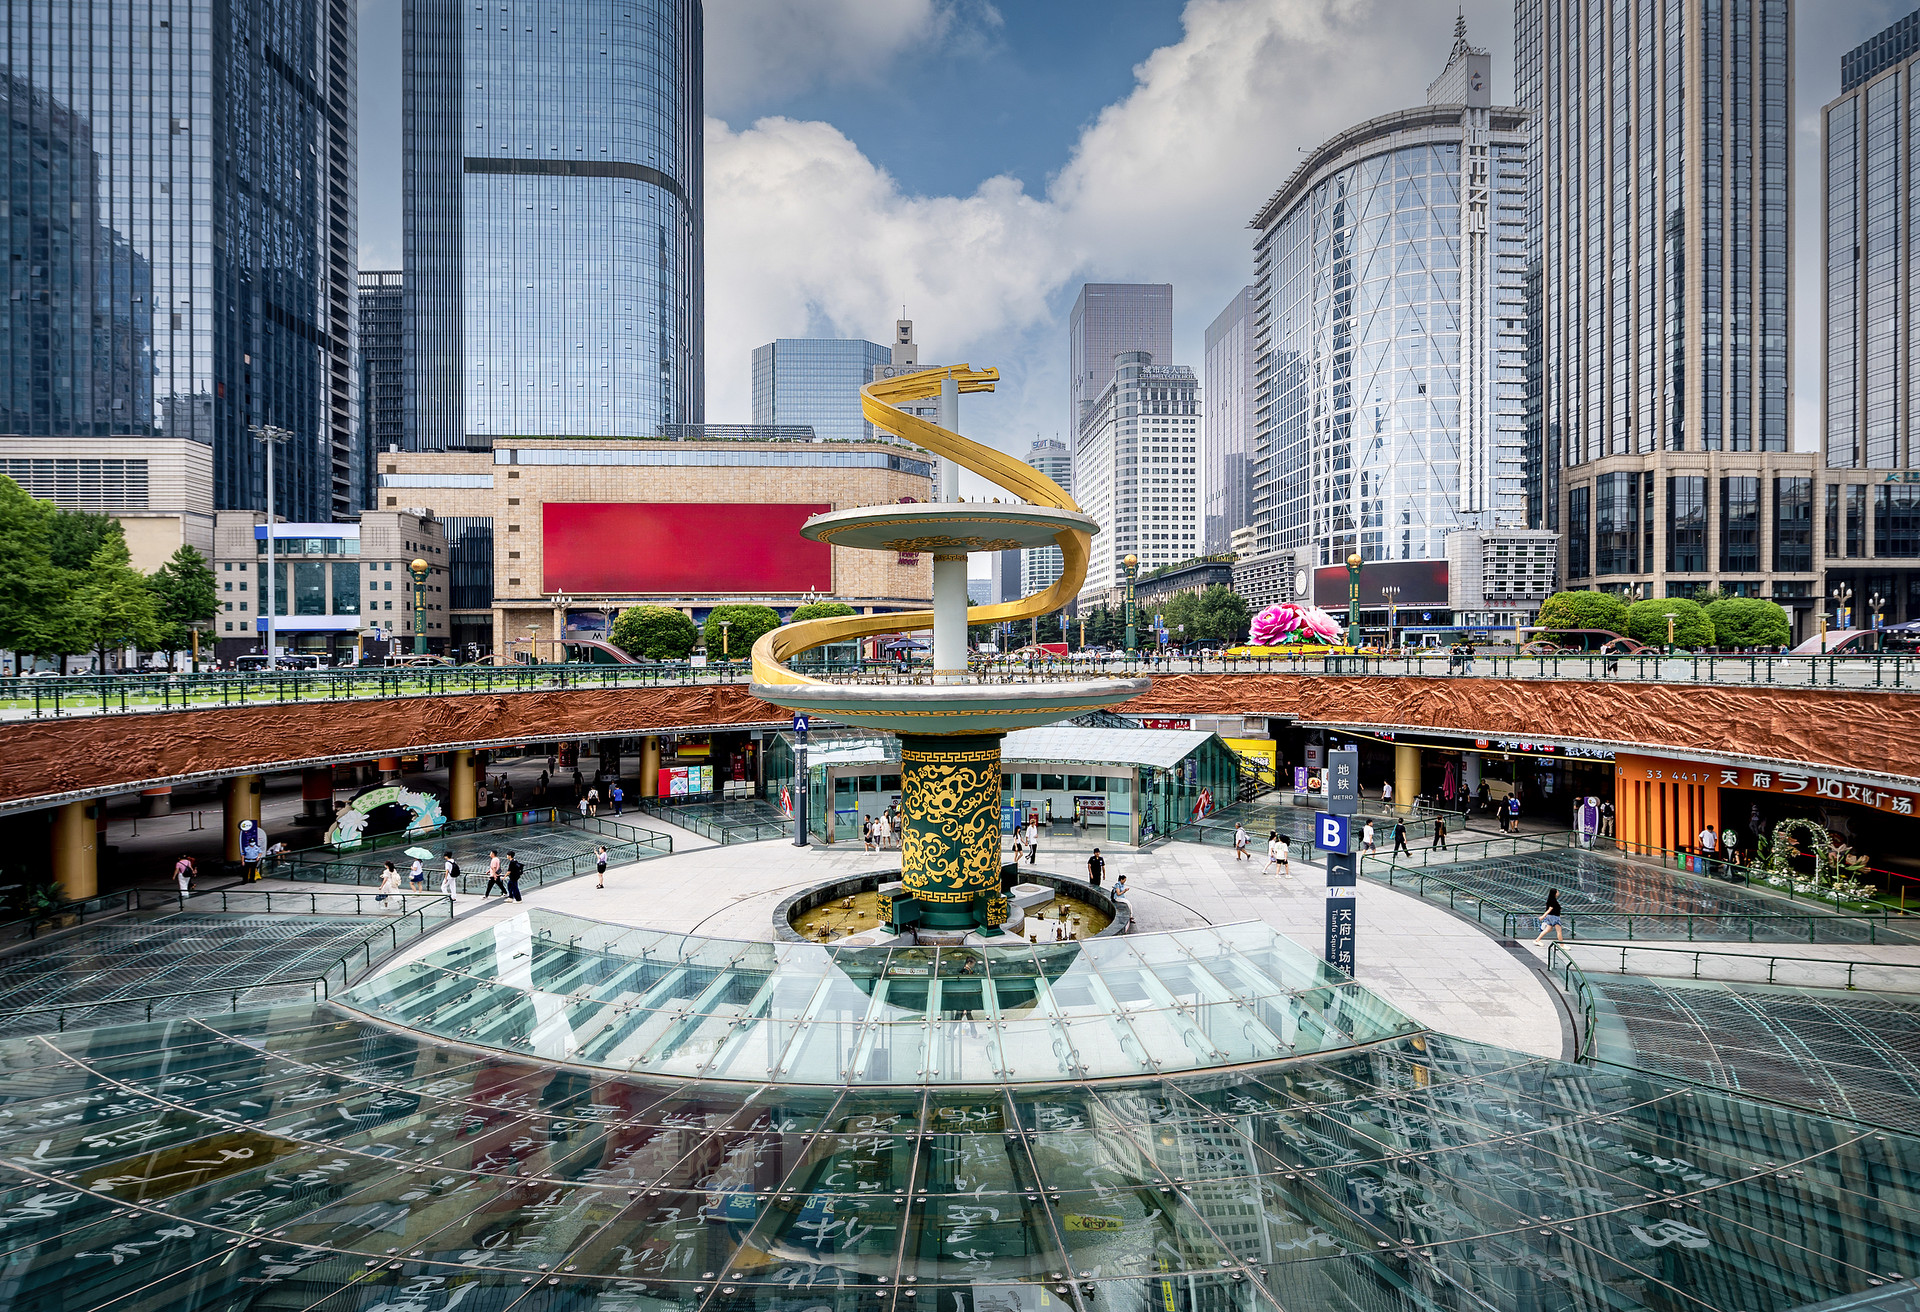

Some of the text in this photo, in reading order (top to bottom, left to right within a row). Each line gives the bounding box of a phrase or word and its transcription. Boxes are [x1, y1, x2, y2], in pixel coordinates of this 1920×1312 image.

[796, 718, 806, 730] A
[1337, 763, 1350, 790] 地铁
[1646, 769, 1662, 779] 33
[1672, 771, 1710, 783] 4417
[1846, 783, 1914, 815] 文化广场
[1323, 818, 1341, 848] B
[1330, 887, 1345, 897] 1/2
[1331, 909, 1339, 933] Tianfu
[1330, 934, 1338, 960] Square
[1339, 908, 1352, 979] 天府广场站
